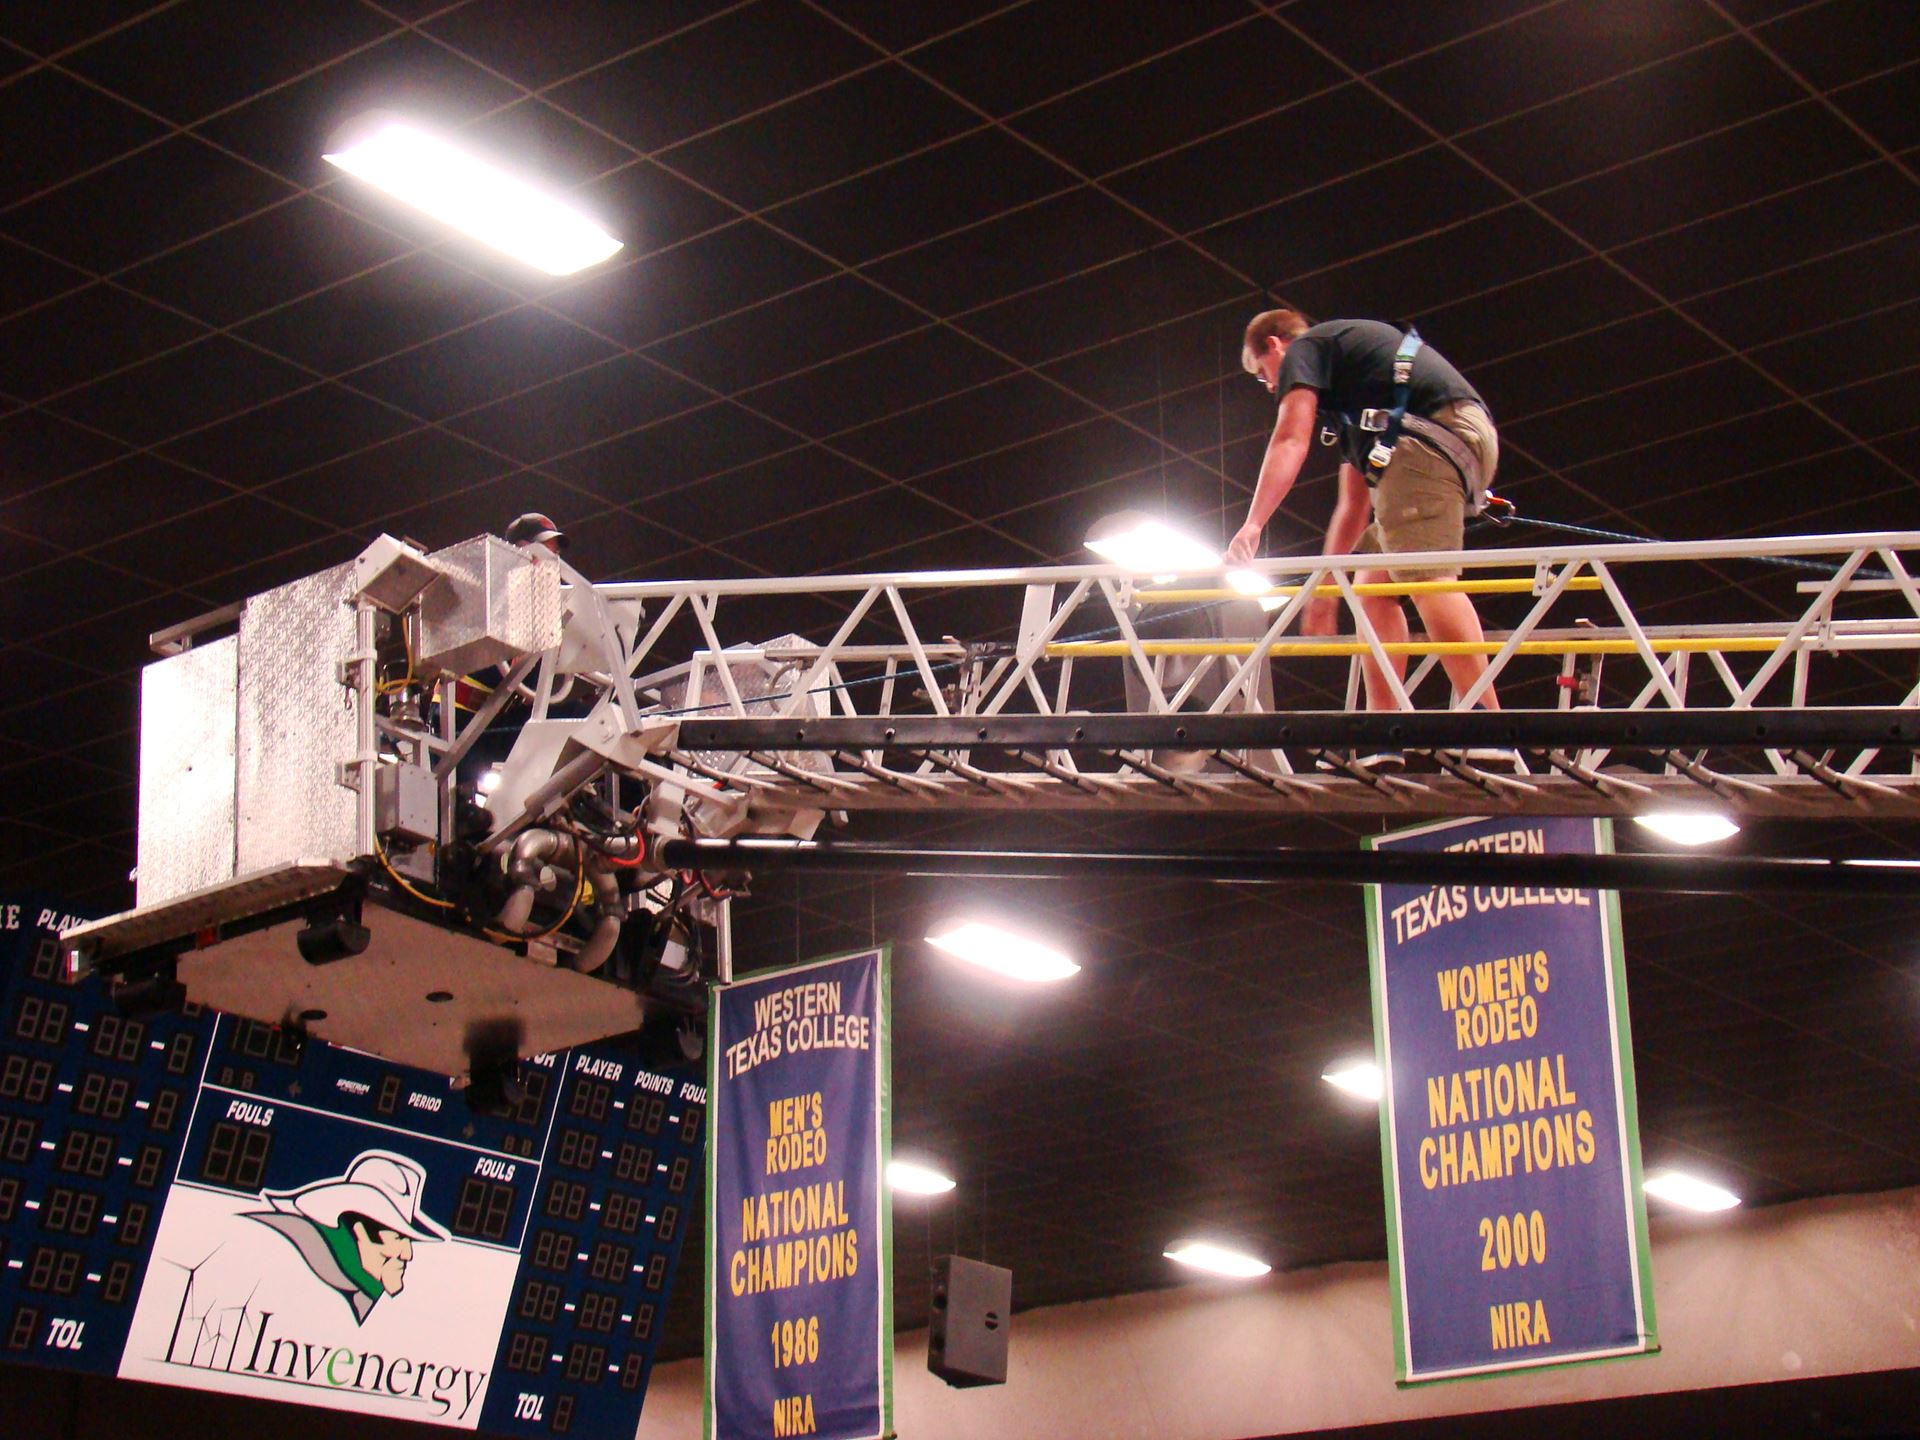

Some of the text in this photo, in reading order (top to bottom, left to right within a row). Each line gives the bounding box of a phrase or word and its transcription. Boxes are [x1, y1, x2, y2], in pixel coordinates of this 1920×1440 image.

[36, 908, 93, 931] PLAY
[1391, 885, 1468, 945] TEXAS
[1437, 950, 1550, 1010] WOMEN'S
[754, 981, 841, 1033] WESTERN
[1454, 992, 1538, 1051] RODEO
[726, 1014, 870, 1080] TEXAS COLLEGE
[407, 1092, 442, 1112] PERIOD
[575, 1054, 623, 1082] PLAYER
[634, 1070, 674, 1095] POINTS
[679, 1082, 707, 1105] FOUL
[1427, 1054, 1577, 1129] NATIONAL
[226, 1100, 274, 1127] FOULS
[768, 1091, 823, 1139] MEN'S
[474, 1157, 516, 1182] FOULS
[766, 1128, 827, 1175] RODEO
[1419, 1110, 1596, 1190] CHAMPIONS
[742, 1180, 849, 1243] NATIONAL
[730, 1229, 858, 1297] CHAMPIONS
[1479, 1210, 1546, 1272] 2000
[46, 1318, 85, 1350] TOL
[771, 1316, 819, 1369] 1986
[1490, 1299, 1551, 1350] NIRA
[243, 1310, 487, 1420] Invenergy
[514, 1393, 544, 1421] TOL
[773, 1394, 816, 1438] NIRA
